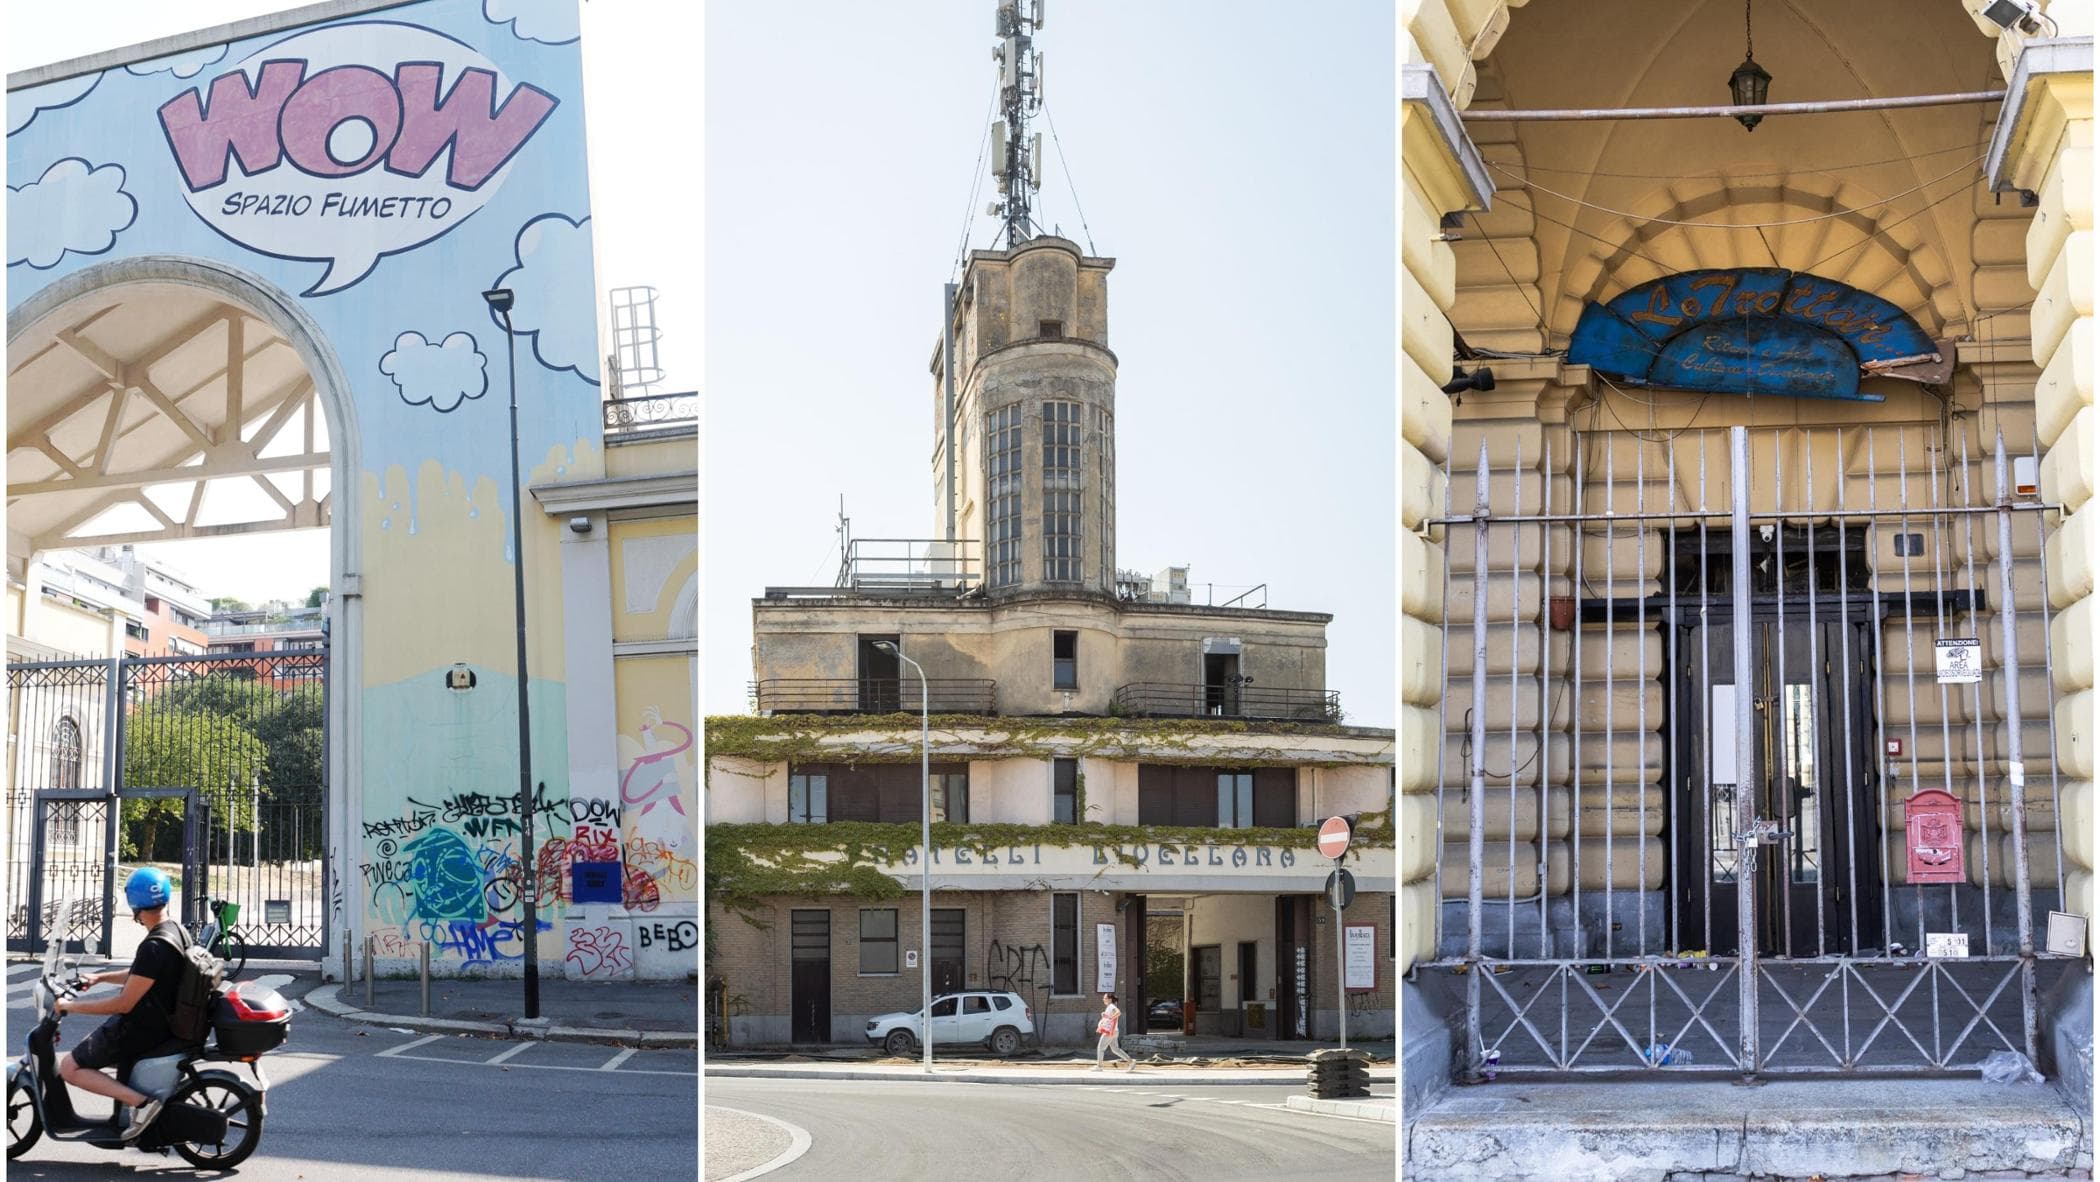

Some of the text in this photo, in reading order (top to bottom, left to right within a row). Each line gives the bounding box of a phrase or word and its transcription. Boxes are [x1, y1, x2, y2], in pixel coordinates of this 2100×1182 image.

[157, 58, 561, 193] WOW
[222, 192, 452, 219] SPAZIO FUMETTO
[1632, 284, 1701, 327] Le
[1950, 661, 1968, 670] AREA
[638, 921, 699, 952] BEBO
